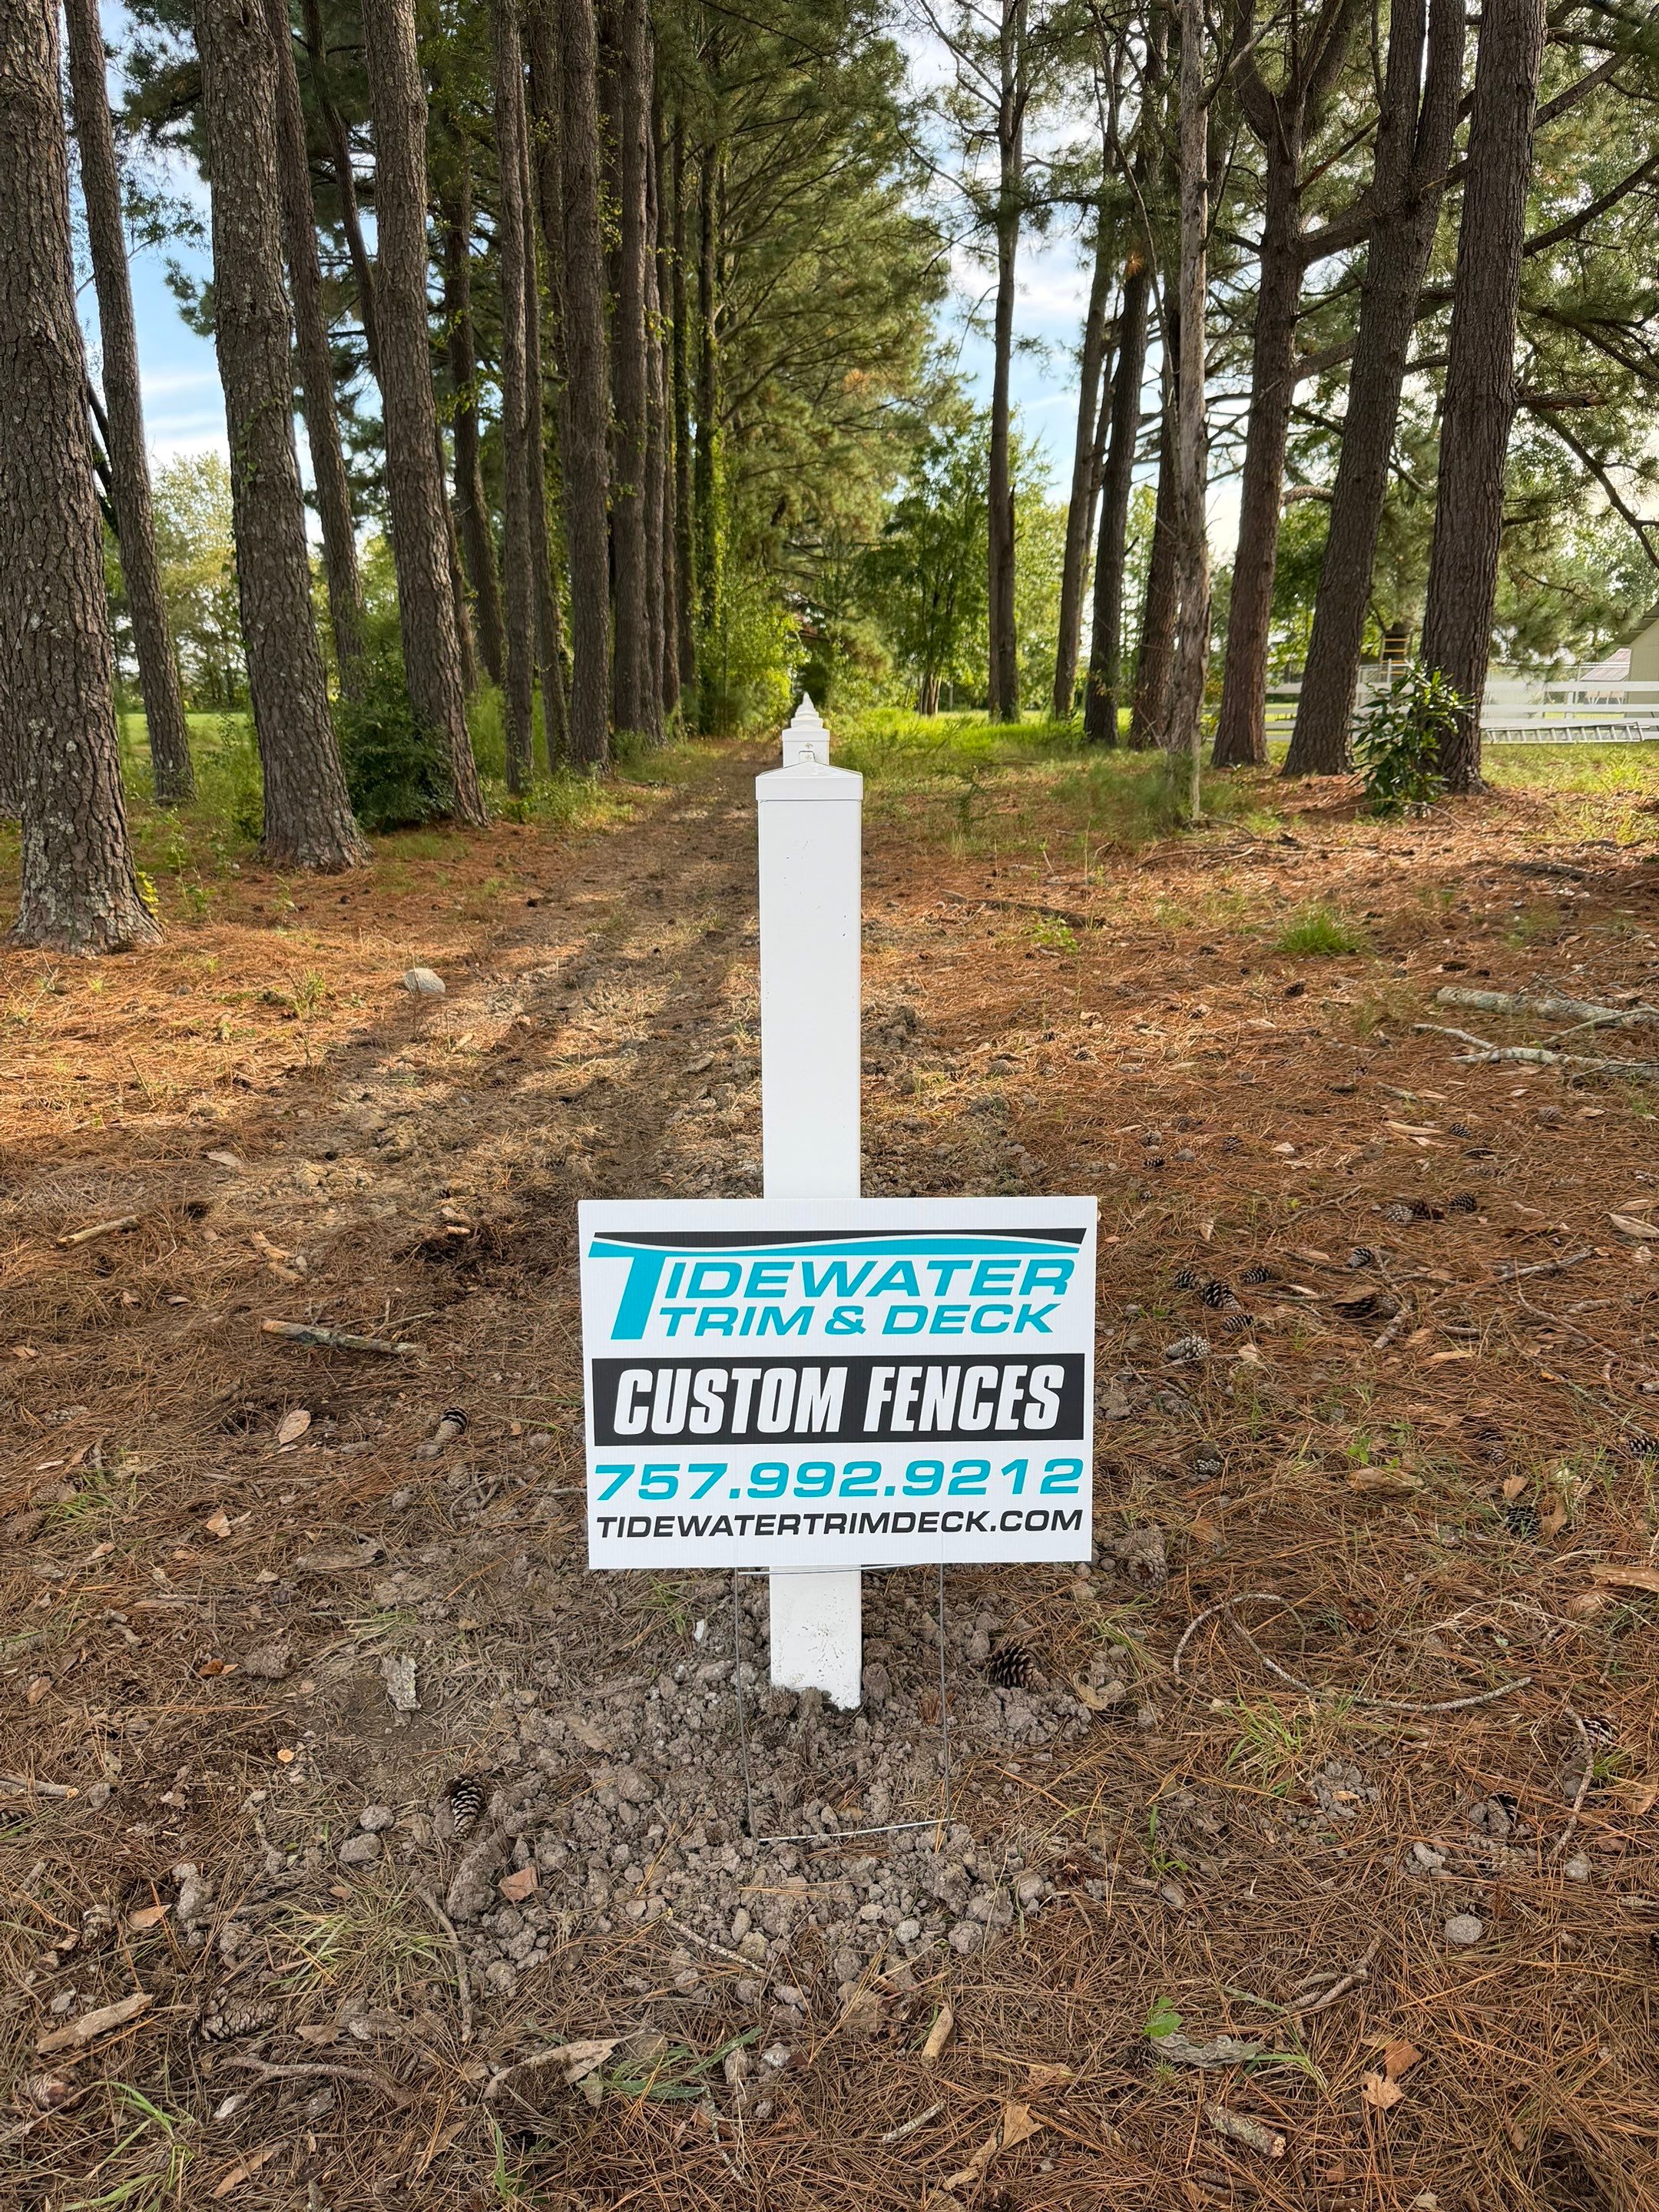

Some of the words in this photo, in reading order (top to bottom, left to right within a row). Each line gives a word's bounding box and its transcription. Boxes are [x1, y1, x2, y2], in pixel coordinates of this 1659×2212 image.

[588, 1237, 1080, 1340] TIDEWATER
[659, 1306, 815, 1337] TRIM
[824, 1305, 867, 1335] &
[882, 1303, 1061, 1334] DECK
[613, 1366, 847, 1435] CUSTOM
[863, 1364, 1065, 1432] FENCES
[594, 1458, 1084, 1501] 757.992.9212
[597, 1509, 1083, 1538] TIDEWATERTRIMDECK.COM
